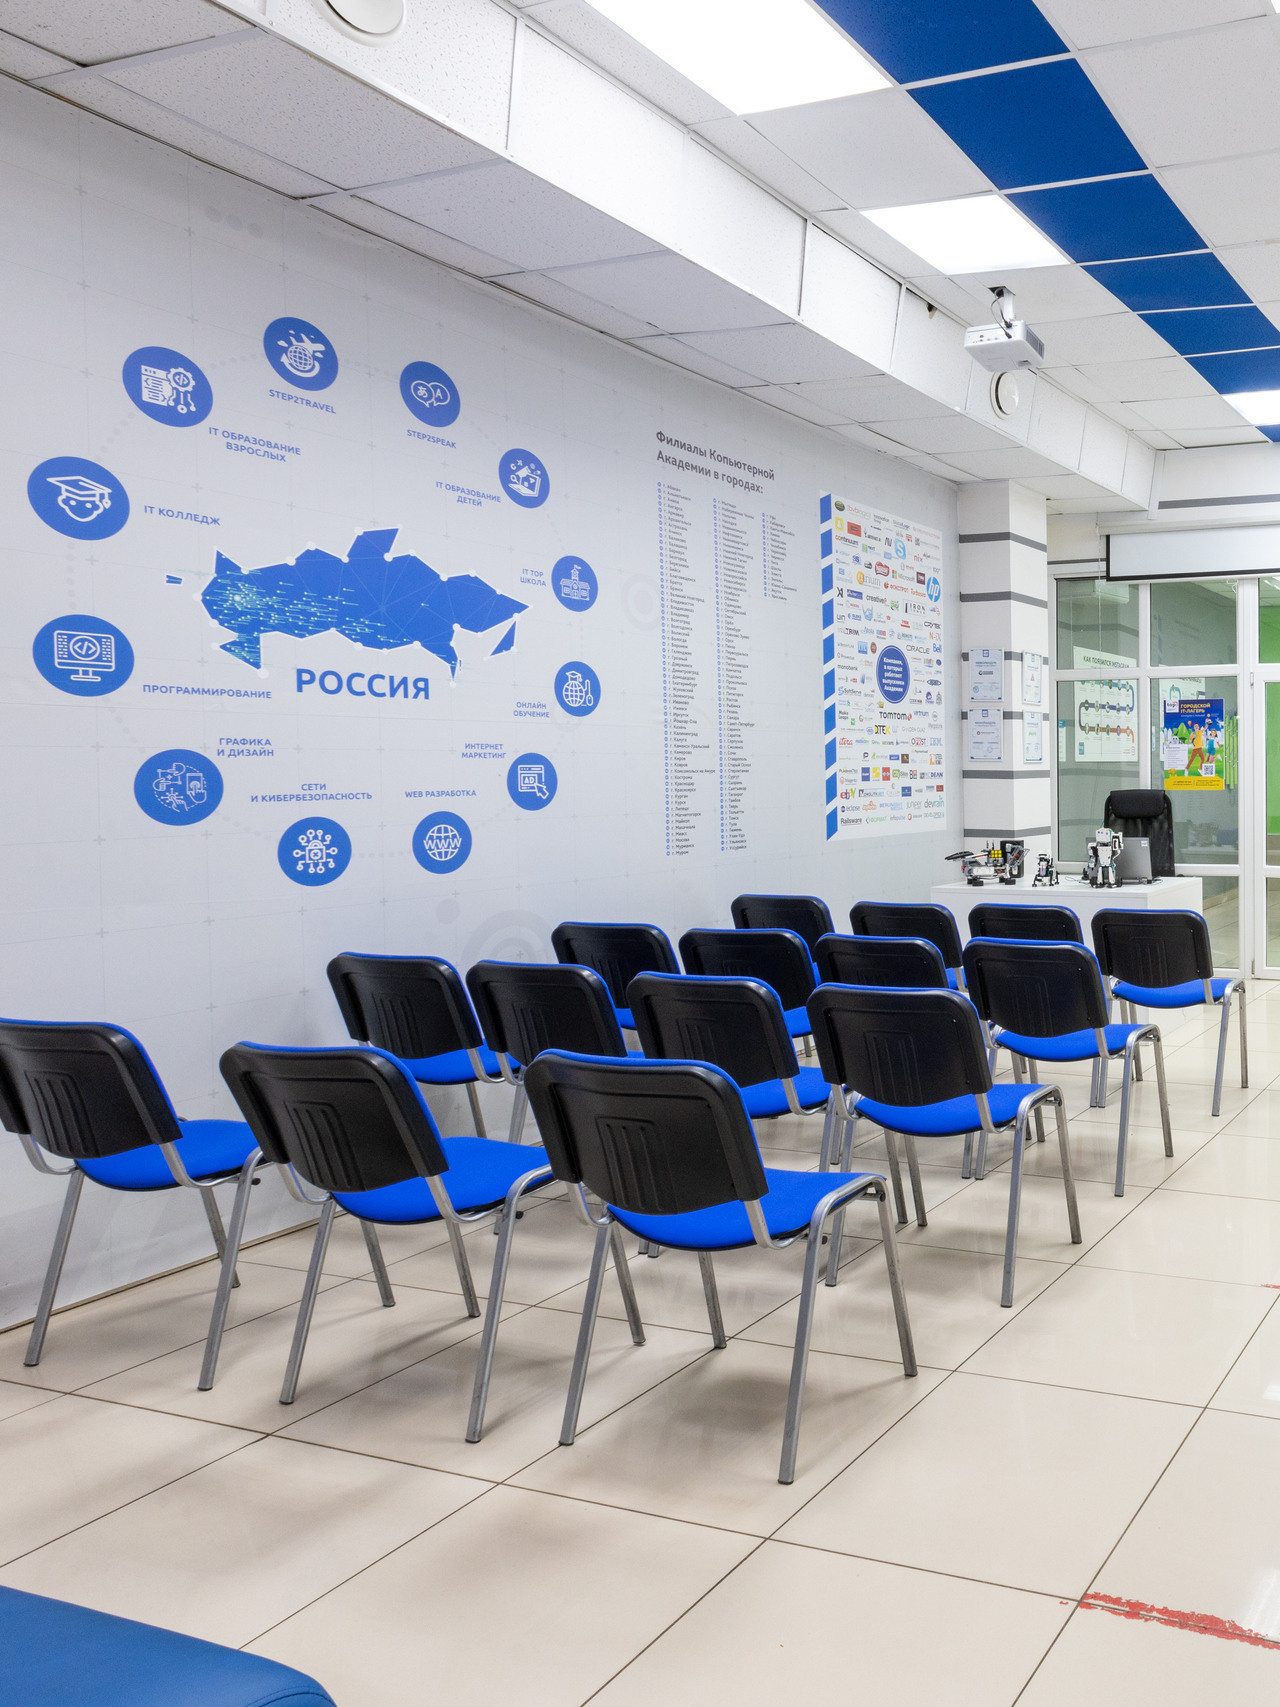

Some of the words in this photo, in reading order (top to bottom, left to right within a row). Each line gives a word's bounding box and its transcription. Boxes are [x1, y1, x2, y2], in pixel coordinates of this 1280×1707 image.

[269, 389, 336, 414] STEP2TRAVEL
[208, 427, 219, 436] IT
[221, 430, 301, 456] ОБРАЗОВАНИЕ
[406, 429, 457, 449] STEP2SPEAK
[225, 441, 287, 463] ВЗРОСЛЫХ
[656, 430, 707, 458] Филиалы
[709, 448, 775, 481] Копьютерной
[656, 450, 711, 477] Академии
[713, 471, 720, 480] в
[721, 473, 764, 494] городах:
[435, 481, 443, 489] IT
[444, 483, 501, 503] ОБРАЗОВАНИЕ
[456, 495, 483, 508] ДЕТЕЙ
[143, 505, 155, 515] IT
[158, 507, 221, 527] КОЛЛЕДЖ
[519, 576, 547, 587] ШКОЛА
[906, 644, 930, 655] ORACLE
[296, 668, 431, 700] РОССИЯ
[142, 684, 272, 699] ПРОГРАММИРОВАНИЕ
[516, 701, 547, 710] ОНЛАЙН
[513, 710, 550, 719] ОБУЧЕНИЕ
[218, 737, 272, 747] ГРАФИКА
[465, 743, 504, 751] ИНТЕРНЕТ
[216, 748, 225, 757] И
[227, 746, 274, 758] ДИЗАЙН
[461, 752, 507, 760] МАРКЕТИНГ
[523, 776, 535, 784] AD
[300, 783, 327, 792] СЕТИ
[250, 794, 259, 803] И
[261, 791, 373, 803] КИБЕРБЕЗОПАСНОСТЬ
[405, 790, 423, 799] WEB
[425, 789, 477, 798] РАЗРАБОТКА
[840, 817, 862, 825] Railsware
